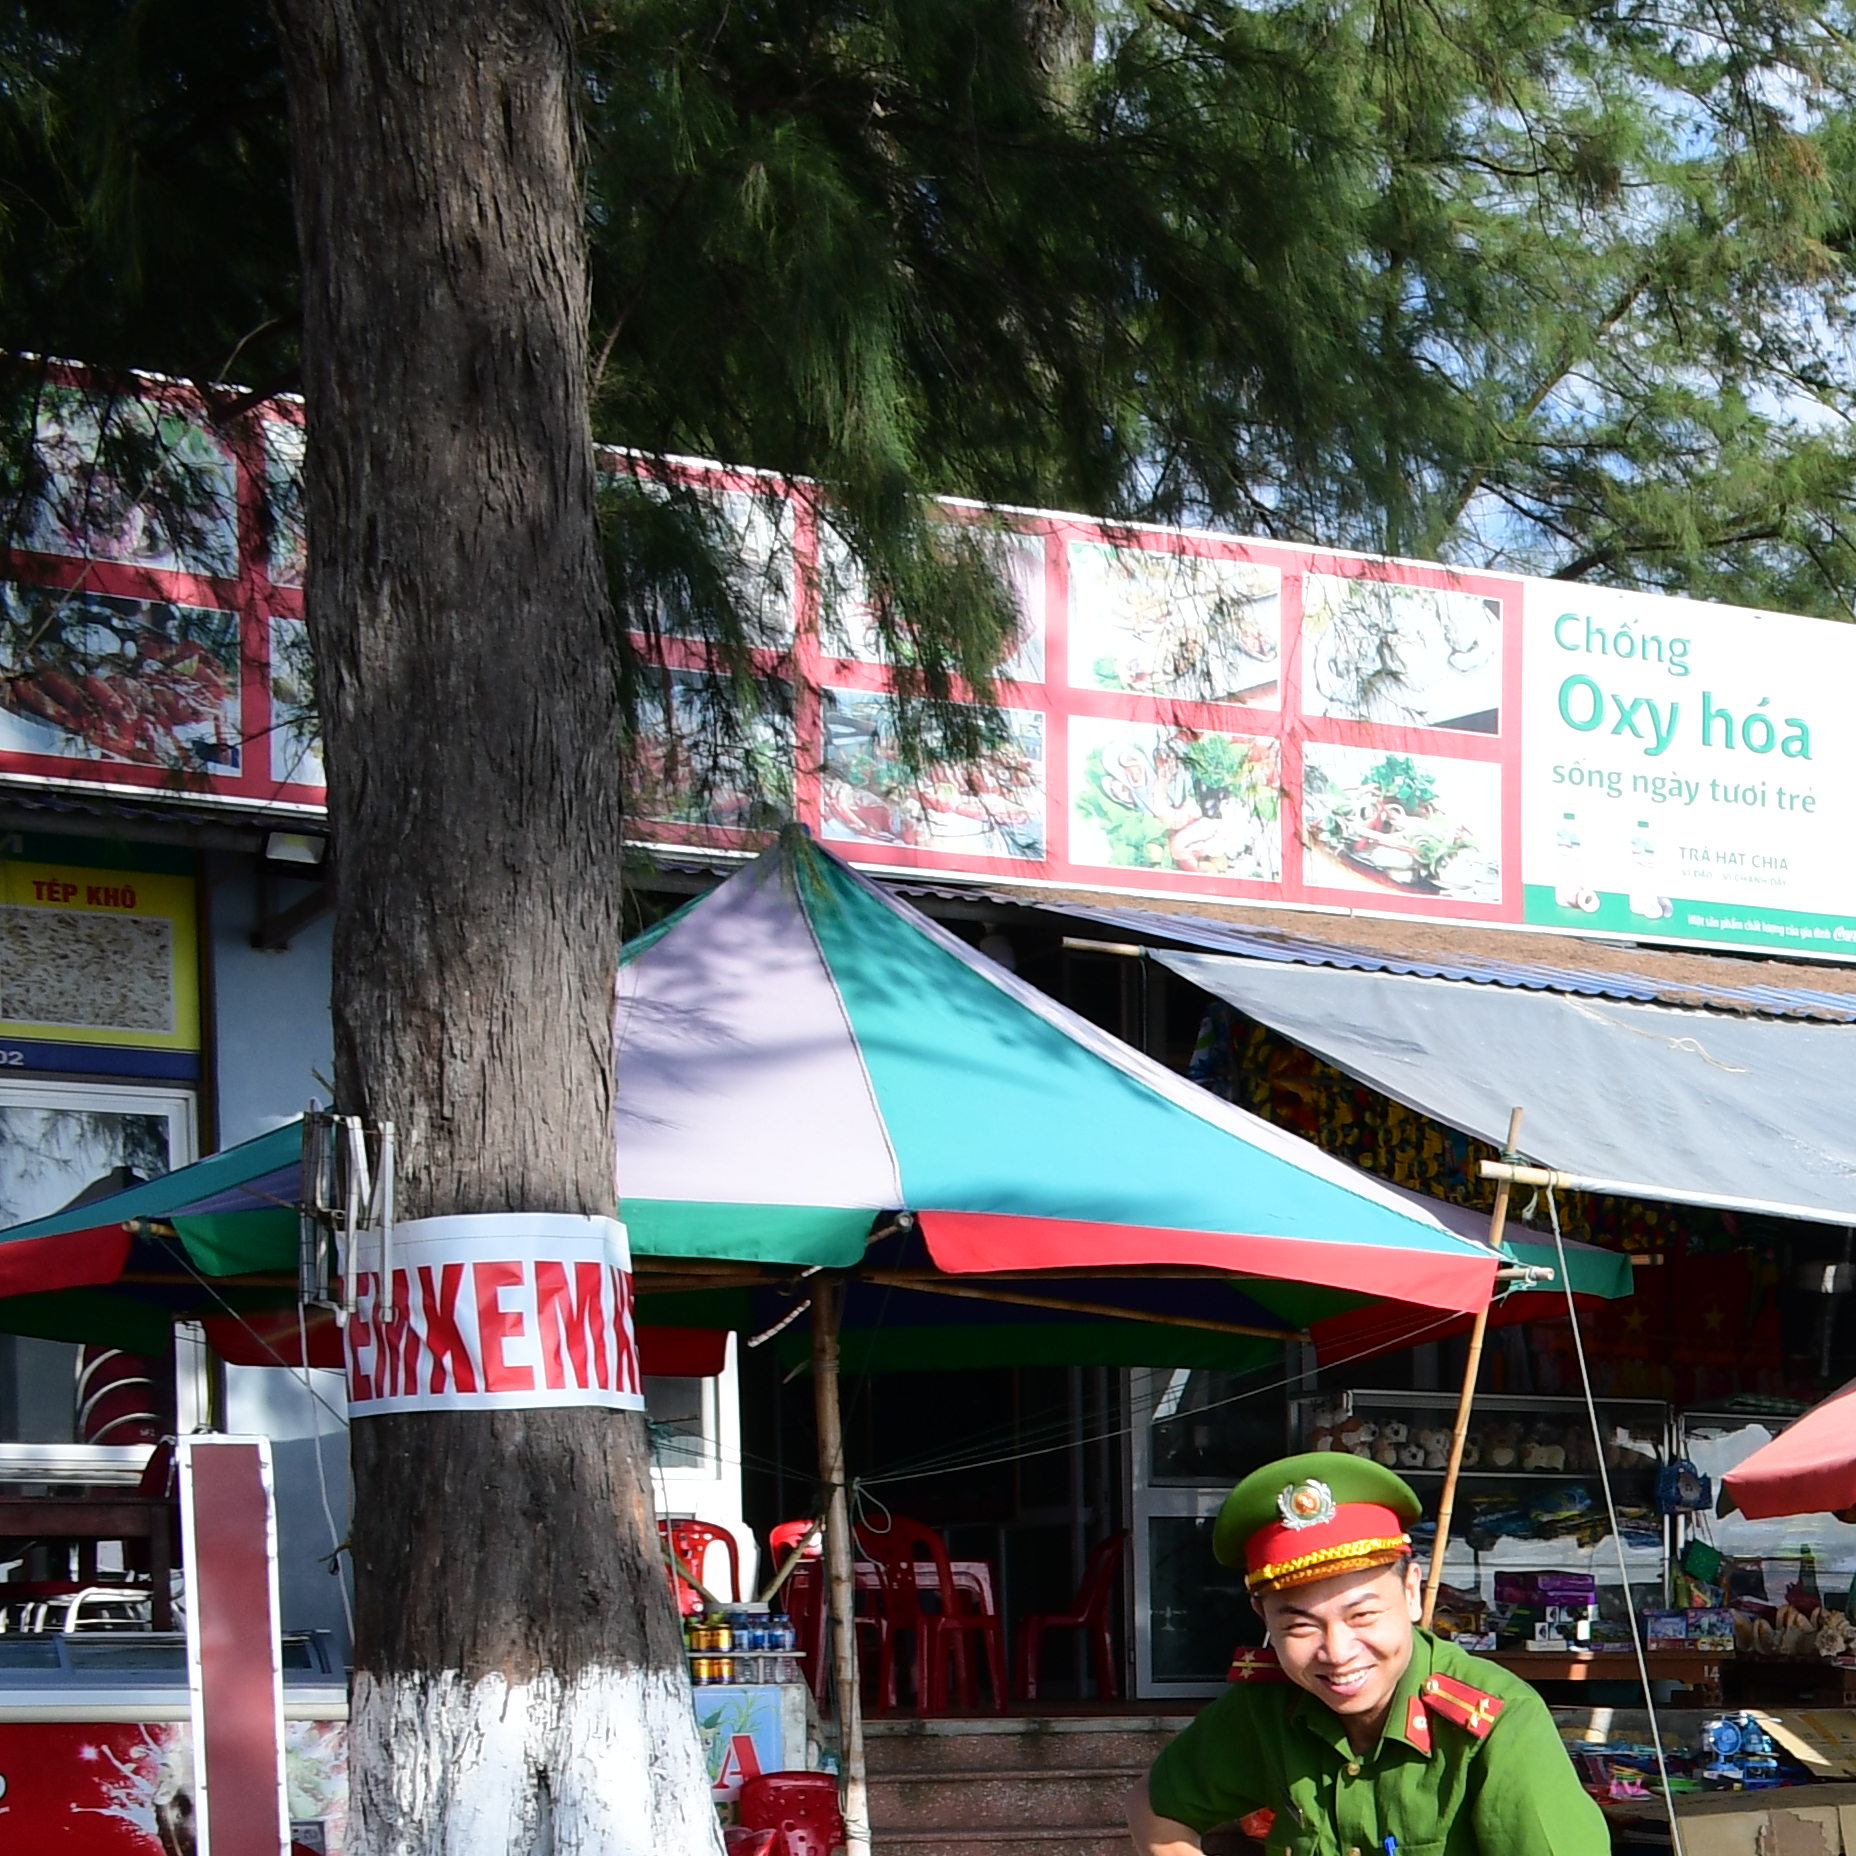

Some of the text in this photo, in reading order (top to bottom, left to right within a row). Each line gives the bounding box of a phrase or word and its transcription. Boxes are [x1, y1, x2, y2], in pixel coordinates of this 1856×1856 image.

[1553, 612, 1692, 677] Chống
[1558, 674, 1814, 761] Oxy hóa
[1552, 759, 1623, 798] sống
[1632, 771, 1700, 806] ngày
[86, 884, 136, 909] KHÔ
